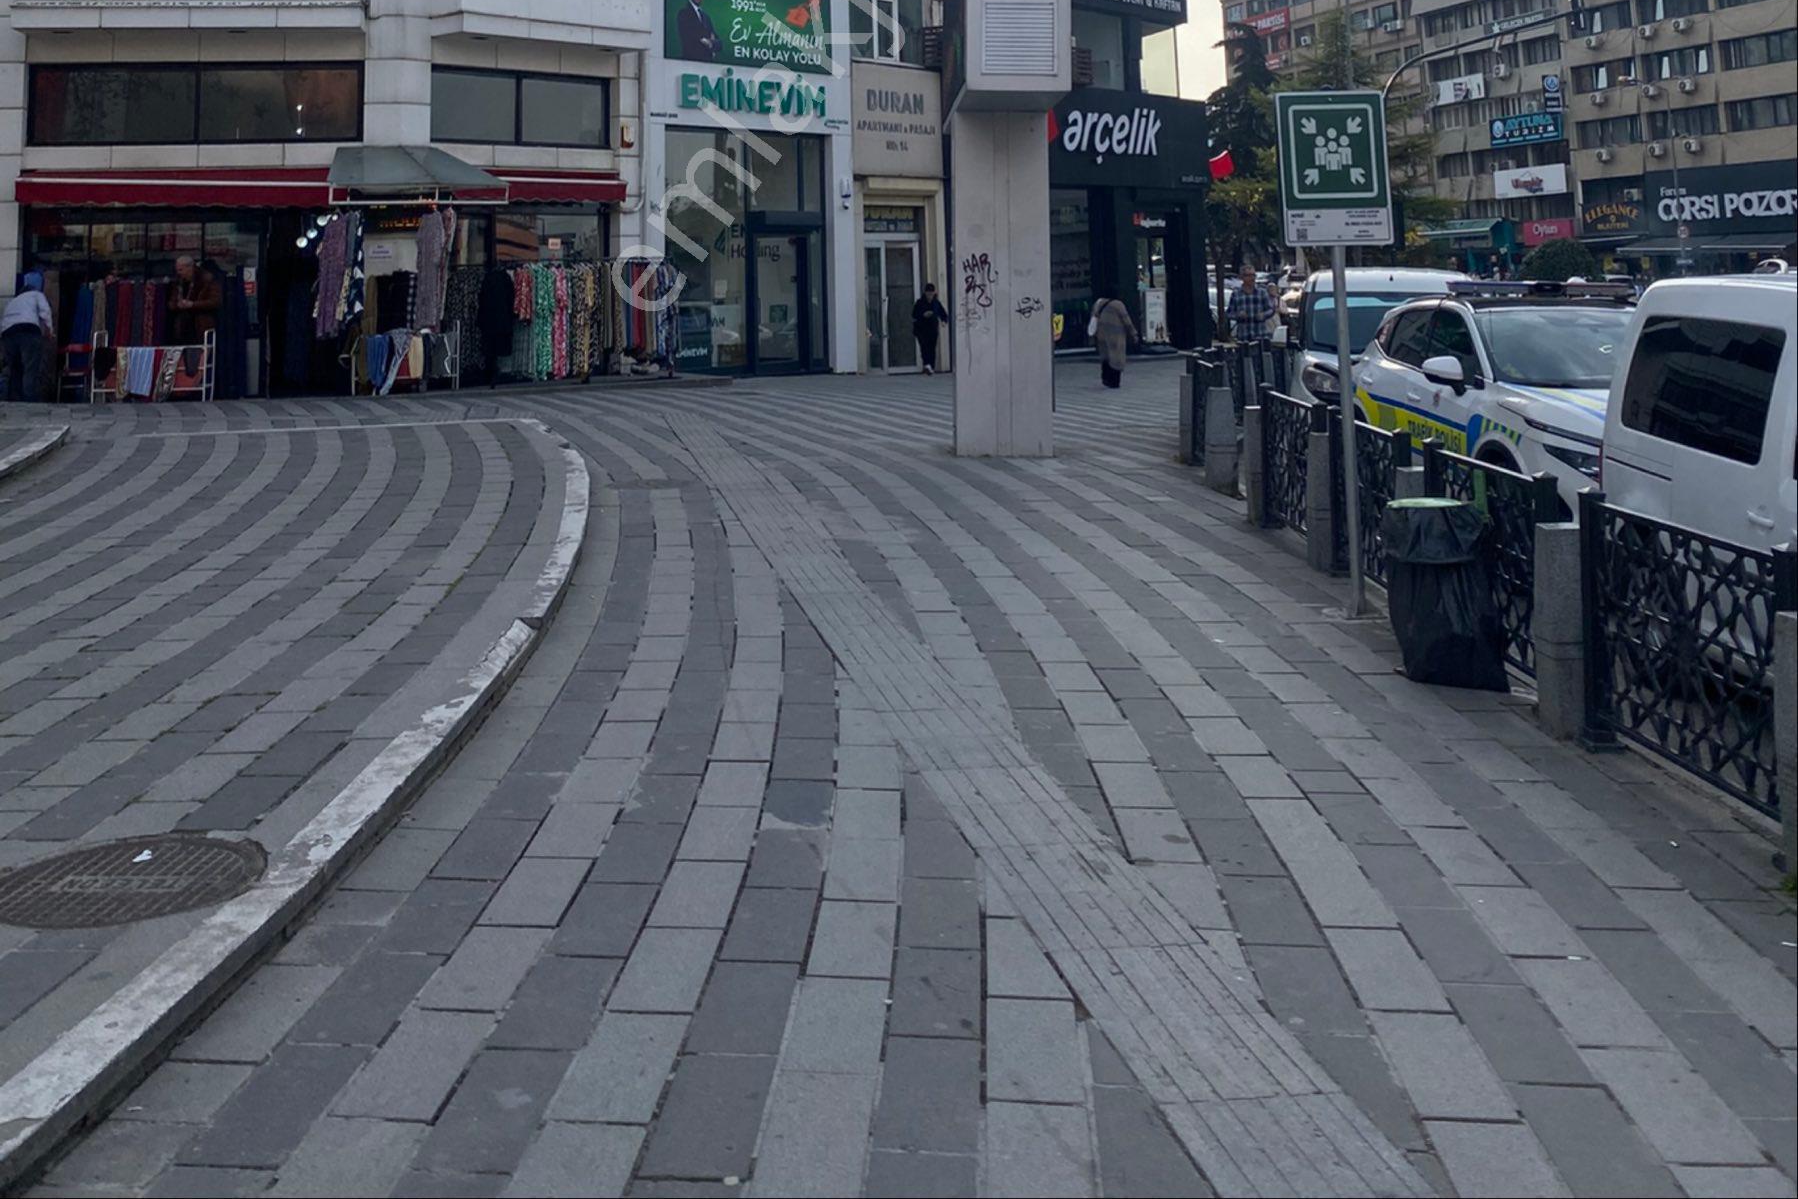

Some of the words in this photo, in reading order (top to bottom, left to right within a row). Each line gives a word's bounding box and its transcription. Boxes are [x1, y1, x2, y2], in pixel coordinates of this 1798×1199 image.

[729, 17, 752, 43] Ev
[734, 46, 750, 58] EN
[752, 48, 790, 63] KOLAY
[793, 51, 821, 66] YOLU
[676, 68, 827, 118] EMİNEVİM
[866, 88, 924, 115] DURAN
[1063, 108, 1162, 164] arçelik
[1584, 203, 1640, 224] ELEGANCE
